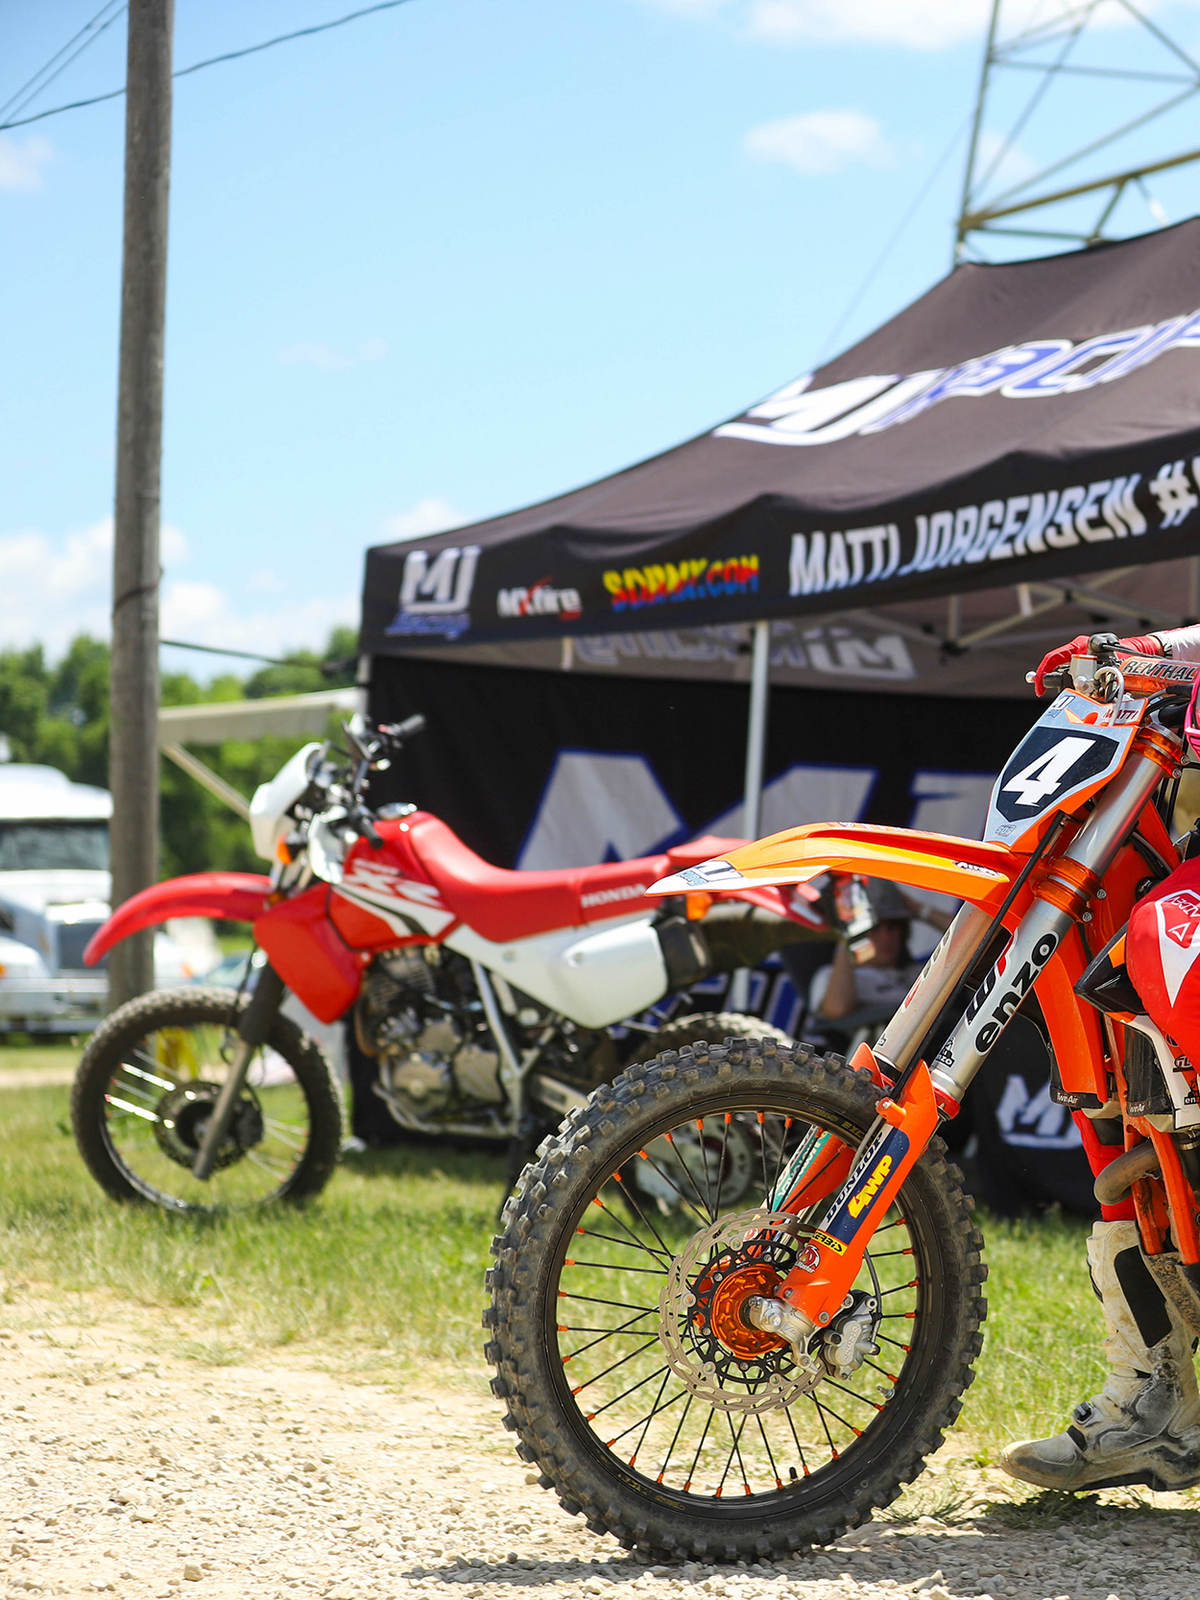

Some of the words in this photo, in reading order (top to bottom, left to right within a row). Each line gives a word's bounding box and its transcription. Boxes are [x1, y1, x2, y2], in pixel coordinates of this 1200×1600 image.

[789, 524, 900, 597] MATTI
[900, 473, 1146, 575] JORGENSEN
[1122, 660, 1200, 682] RENTHAL
[1002, 736, 1096, 807] 4
[975, 930, 1060, 1056] enzo
[826, 1131, 884, 1225] DUNLOP
